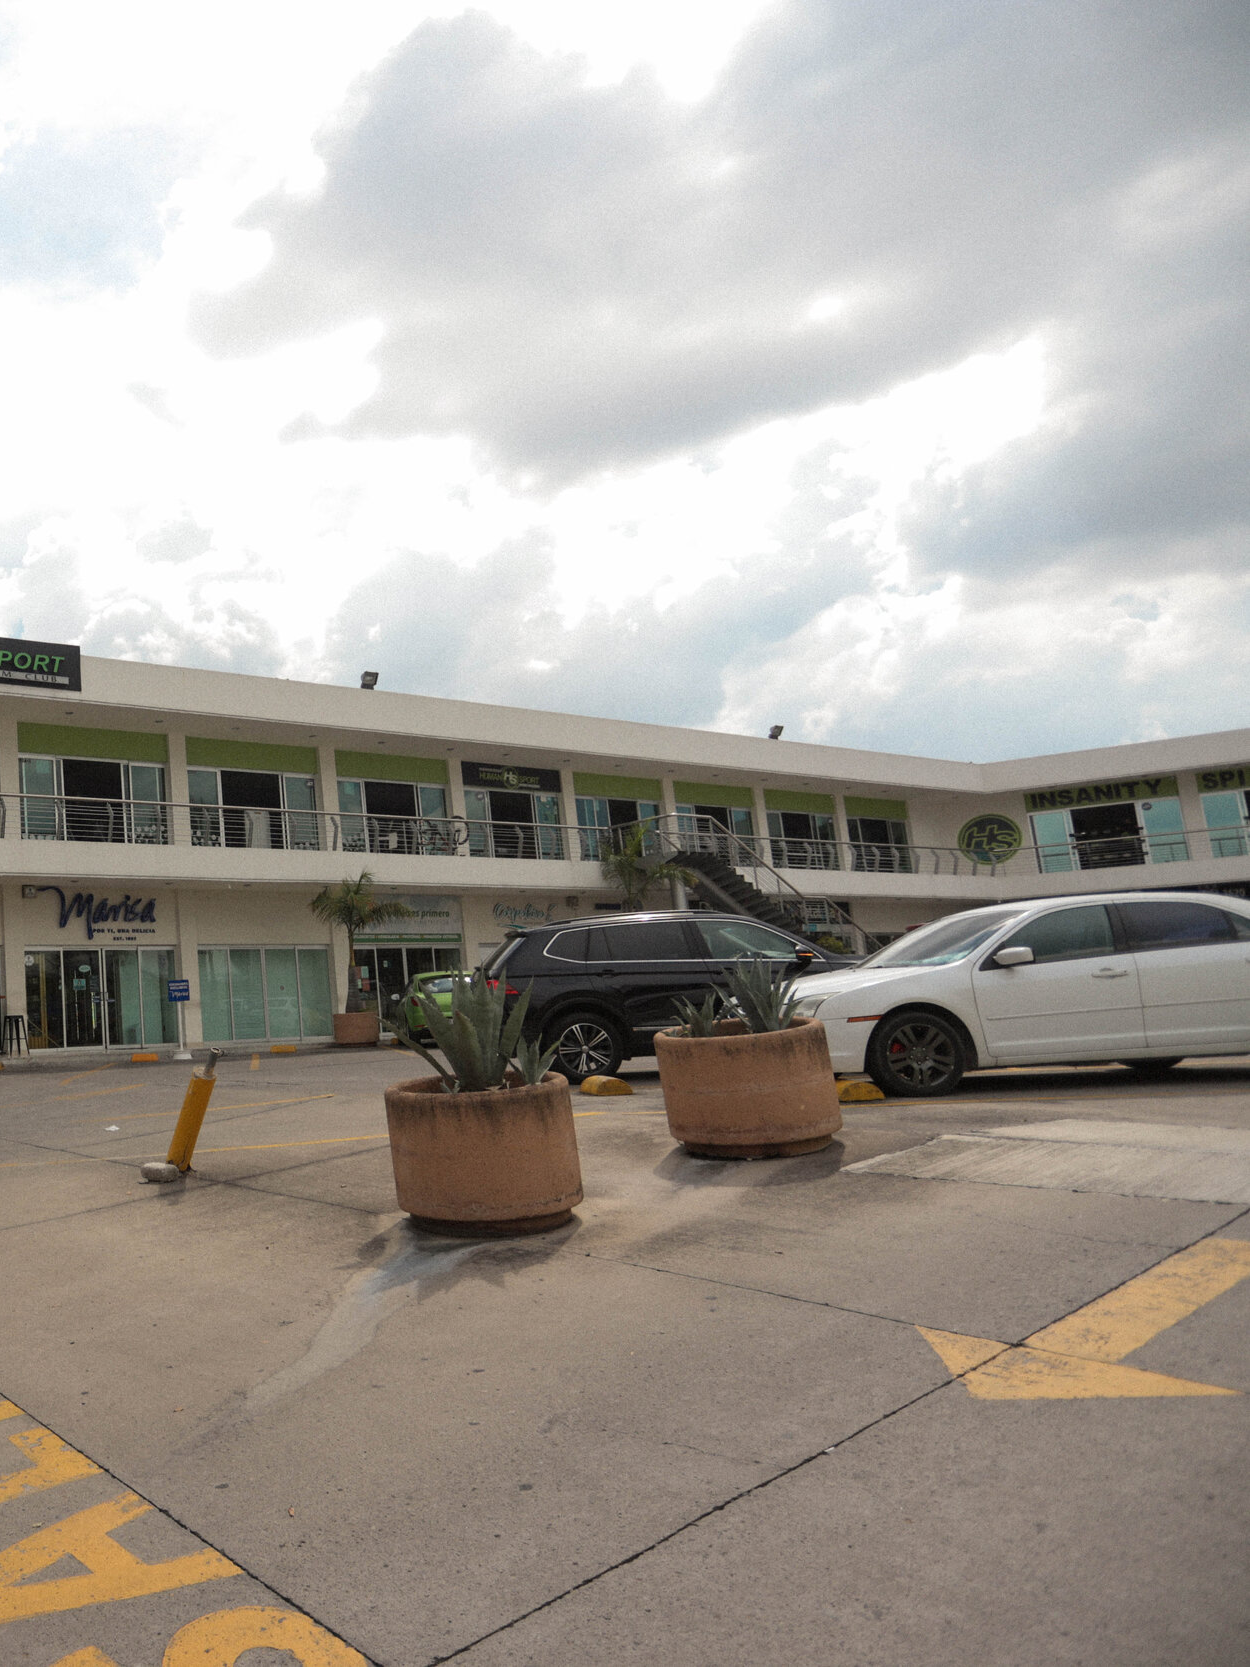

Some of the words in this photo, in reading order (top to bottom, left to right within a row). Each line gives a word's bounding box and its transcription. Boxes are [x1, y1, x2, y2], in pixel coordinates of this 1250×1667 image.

[25, 673, 58, 683] CLUB
[1202, 768, 1246, 790] SPI
[1030, 777, 1163, 808] INSANITY
[37, 885, 157, 940] Marisa
